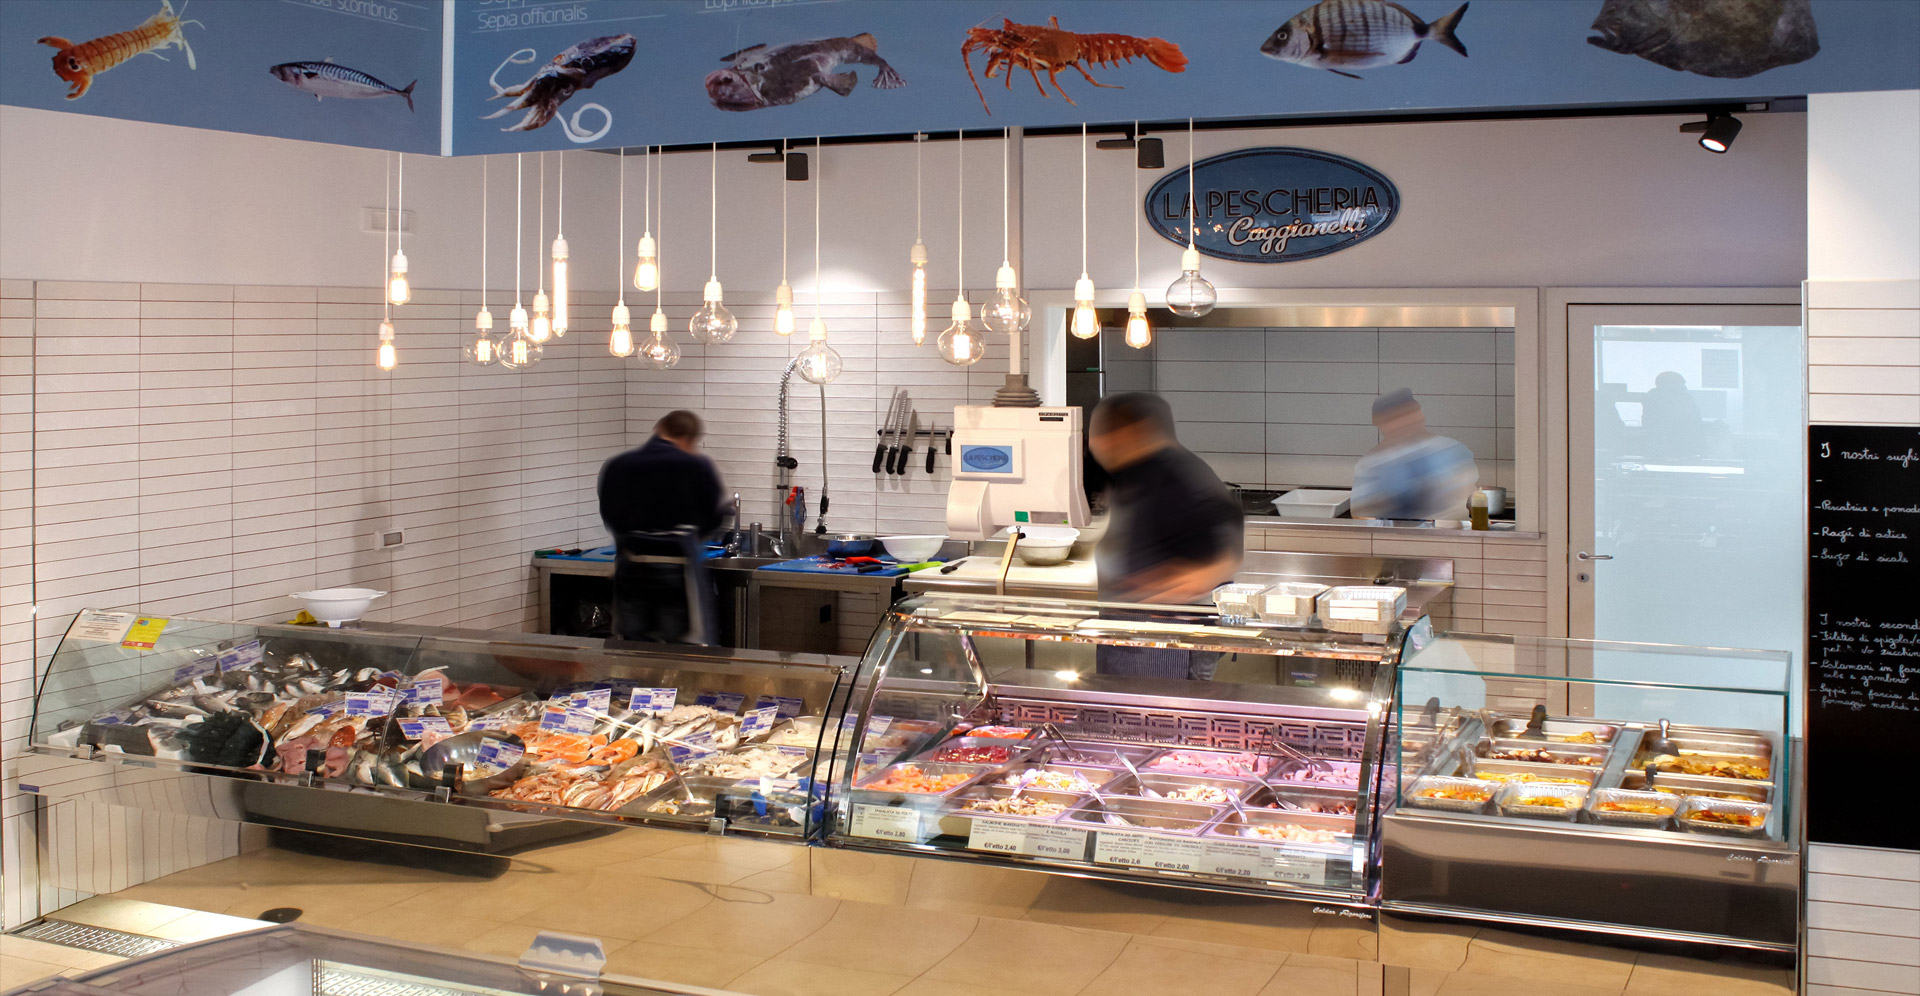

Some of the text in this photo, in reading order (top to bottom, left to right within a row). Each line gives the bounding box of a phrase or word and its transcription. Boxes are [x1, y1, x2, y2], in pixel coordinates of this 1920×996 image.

[478, 12, 518, 32] Sepia
[521, 4, 588, 26] officinalis
[1163, 185, 1382, 219] LA PESCHERIA
[1227, 206, 1369, 254] Caggianelli
[1841, 447, 1879, 460] nostri
[1886, 447, 1920, 468] sughi
[1859, 528, 1871, 538] di
[1836, 617, 1872, 628] nostri
